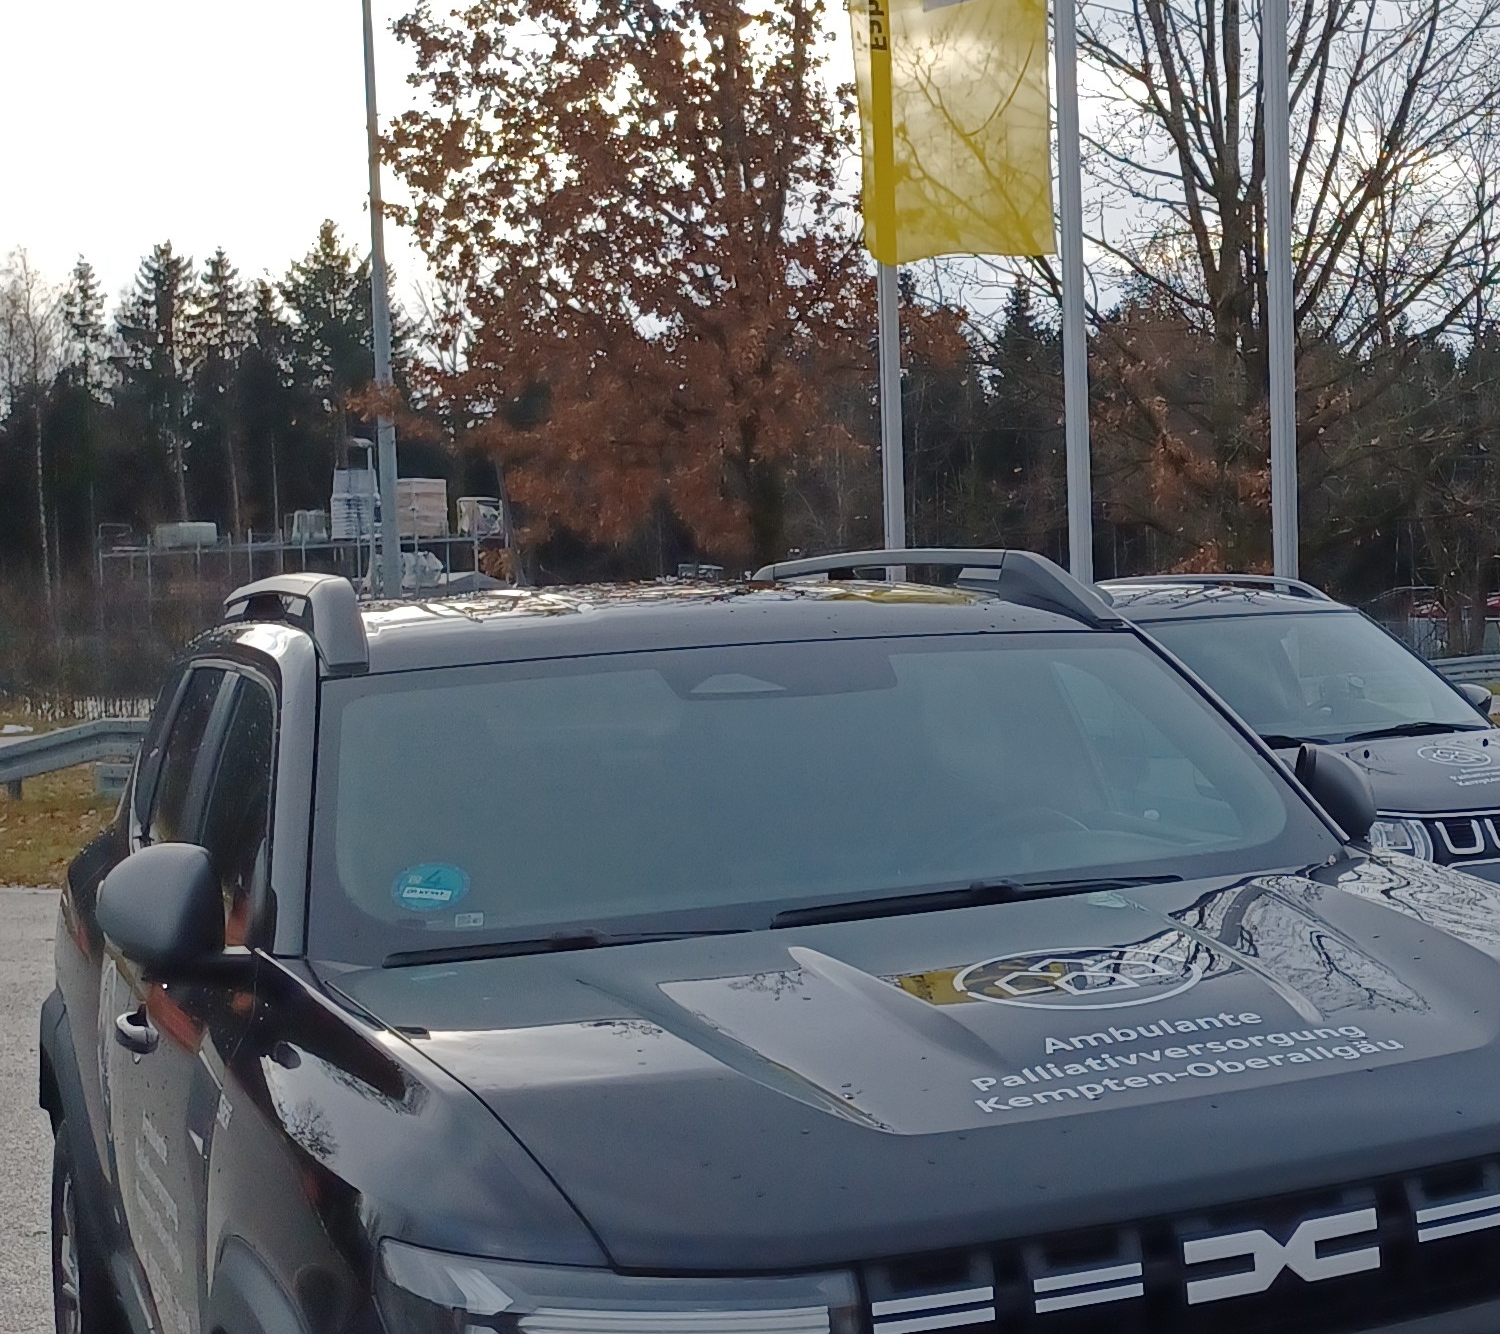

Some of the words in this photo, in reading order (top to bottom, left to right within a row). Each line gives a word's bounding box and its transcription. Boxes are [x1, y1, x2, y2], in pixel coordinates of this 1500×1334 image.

[970, 1023, 1366, 1092] Palliativversorgung
[1045, 1009, 1263, 1055] Ambulante
[974, 1037, 1404, 1113] Kempten-Oberallgäu
